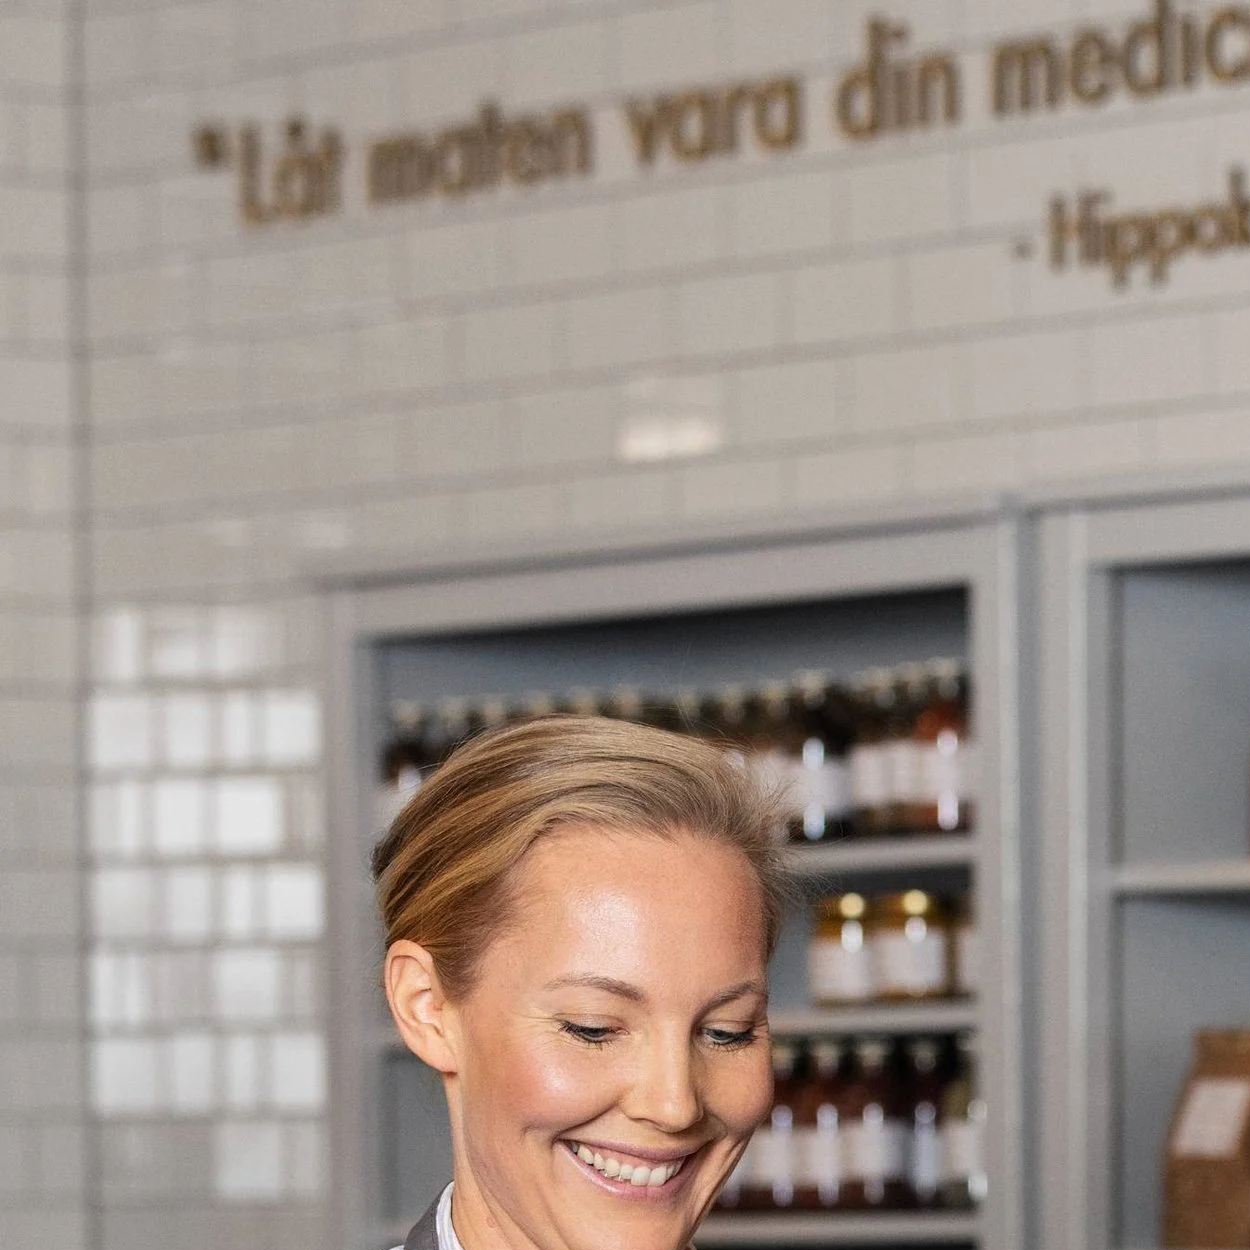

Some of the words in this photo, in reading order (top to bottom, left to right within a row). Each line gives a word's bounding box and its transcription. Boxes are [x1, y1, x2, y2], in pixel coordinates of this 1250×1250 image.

[364, 98, 593, 208] maten
[622, 72, 803, 166] vara
[834, 12, 962, 141] din
